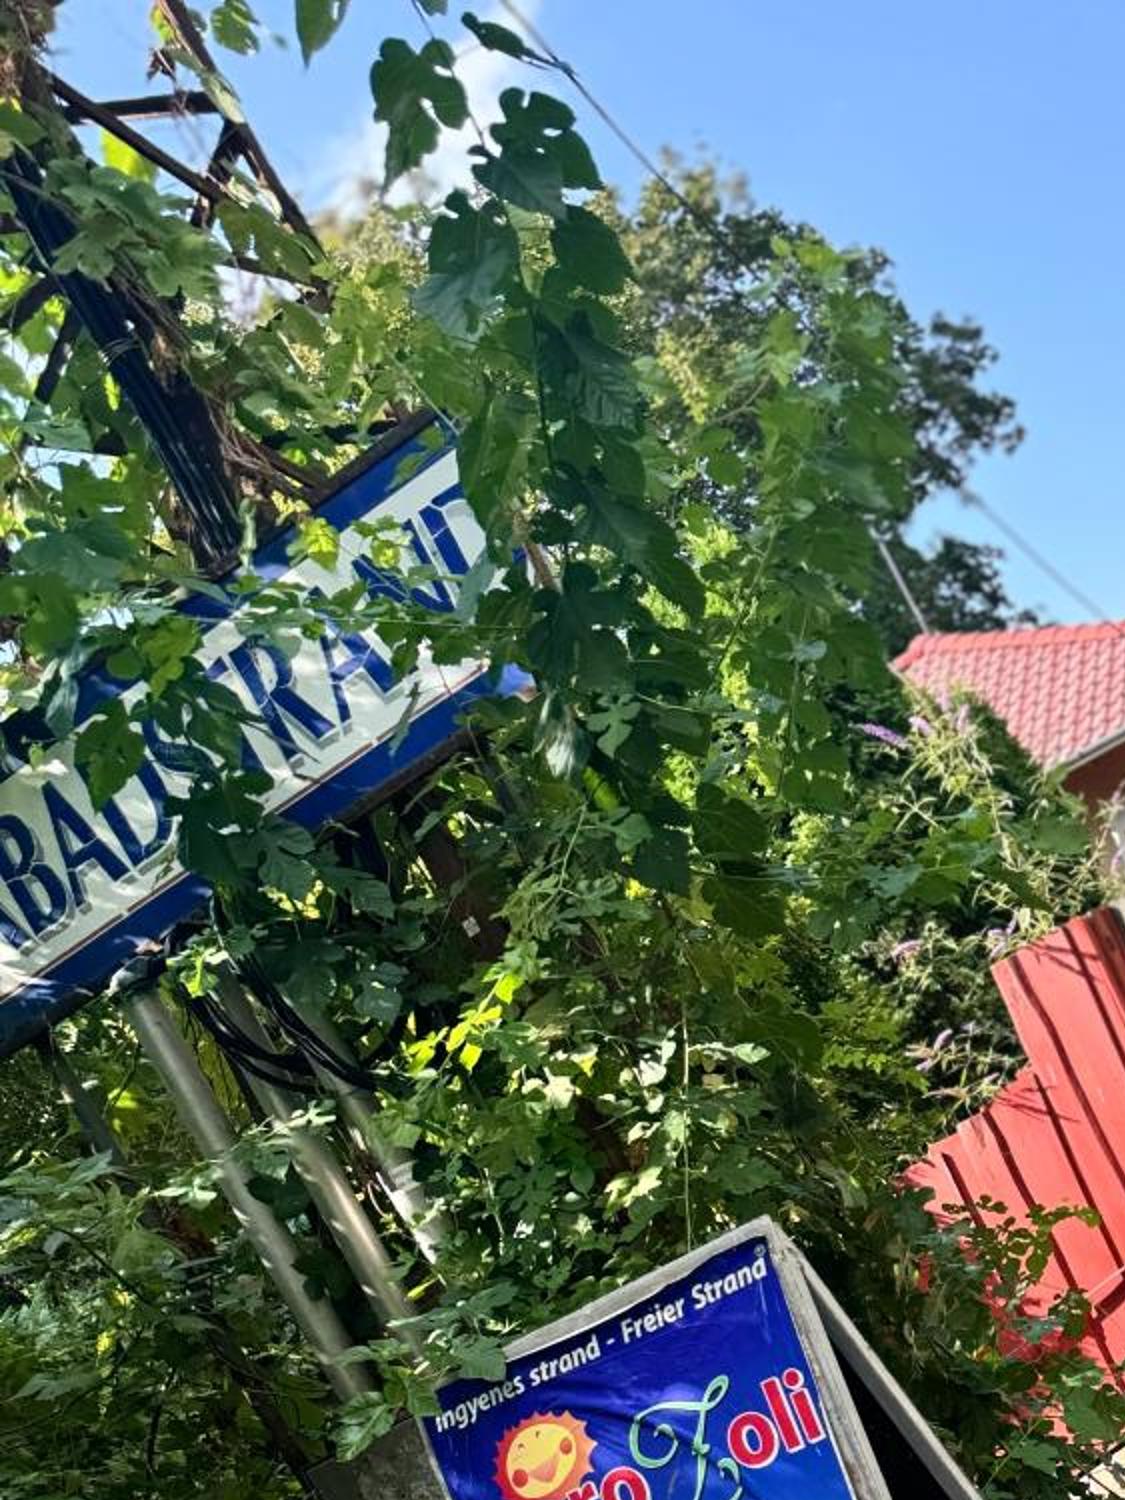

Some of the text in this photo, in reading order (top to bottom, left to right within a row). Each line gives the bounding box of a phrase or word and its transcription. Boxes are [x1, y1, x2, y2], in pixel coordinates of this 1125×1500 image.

[530, 1336, 601, 1388] strand
[605, 1337, 616, 1347] -
[621, 1299, 686, 1345] Freier
[691, 1257, 768, 1311] Strand
